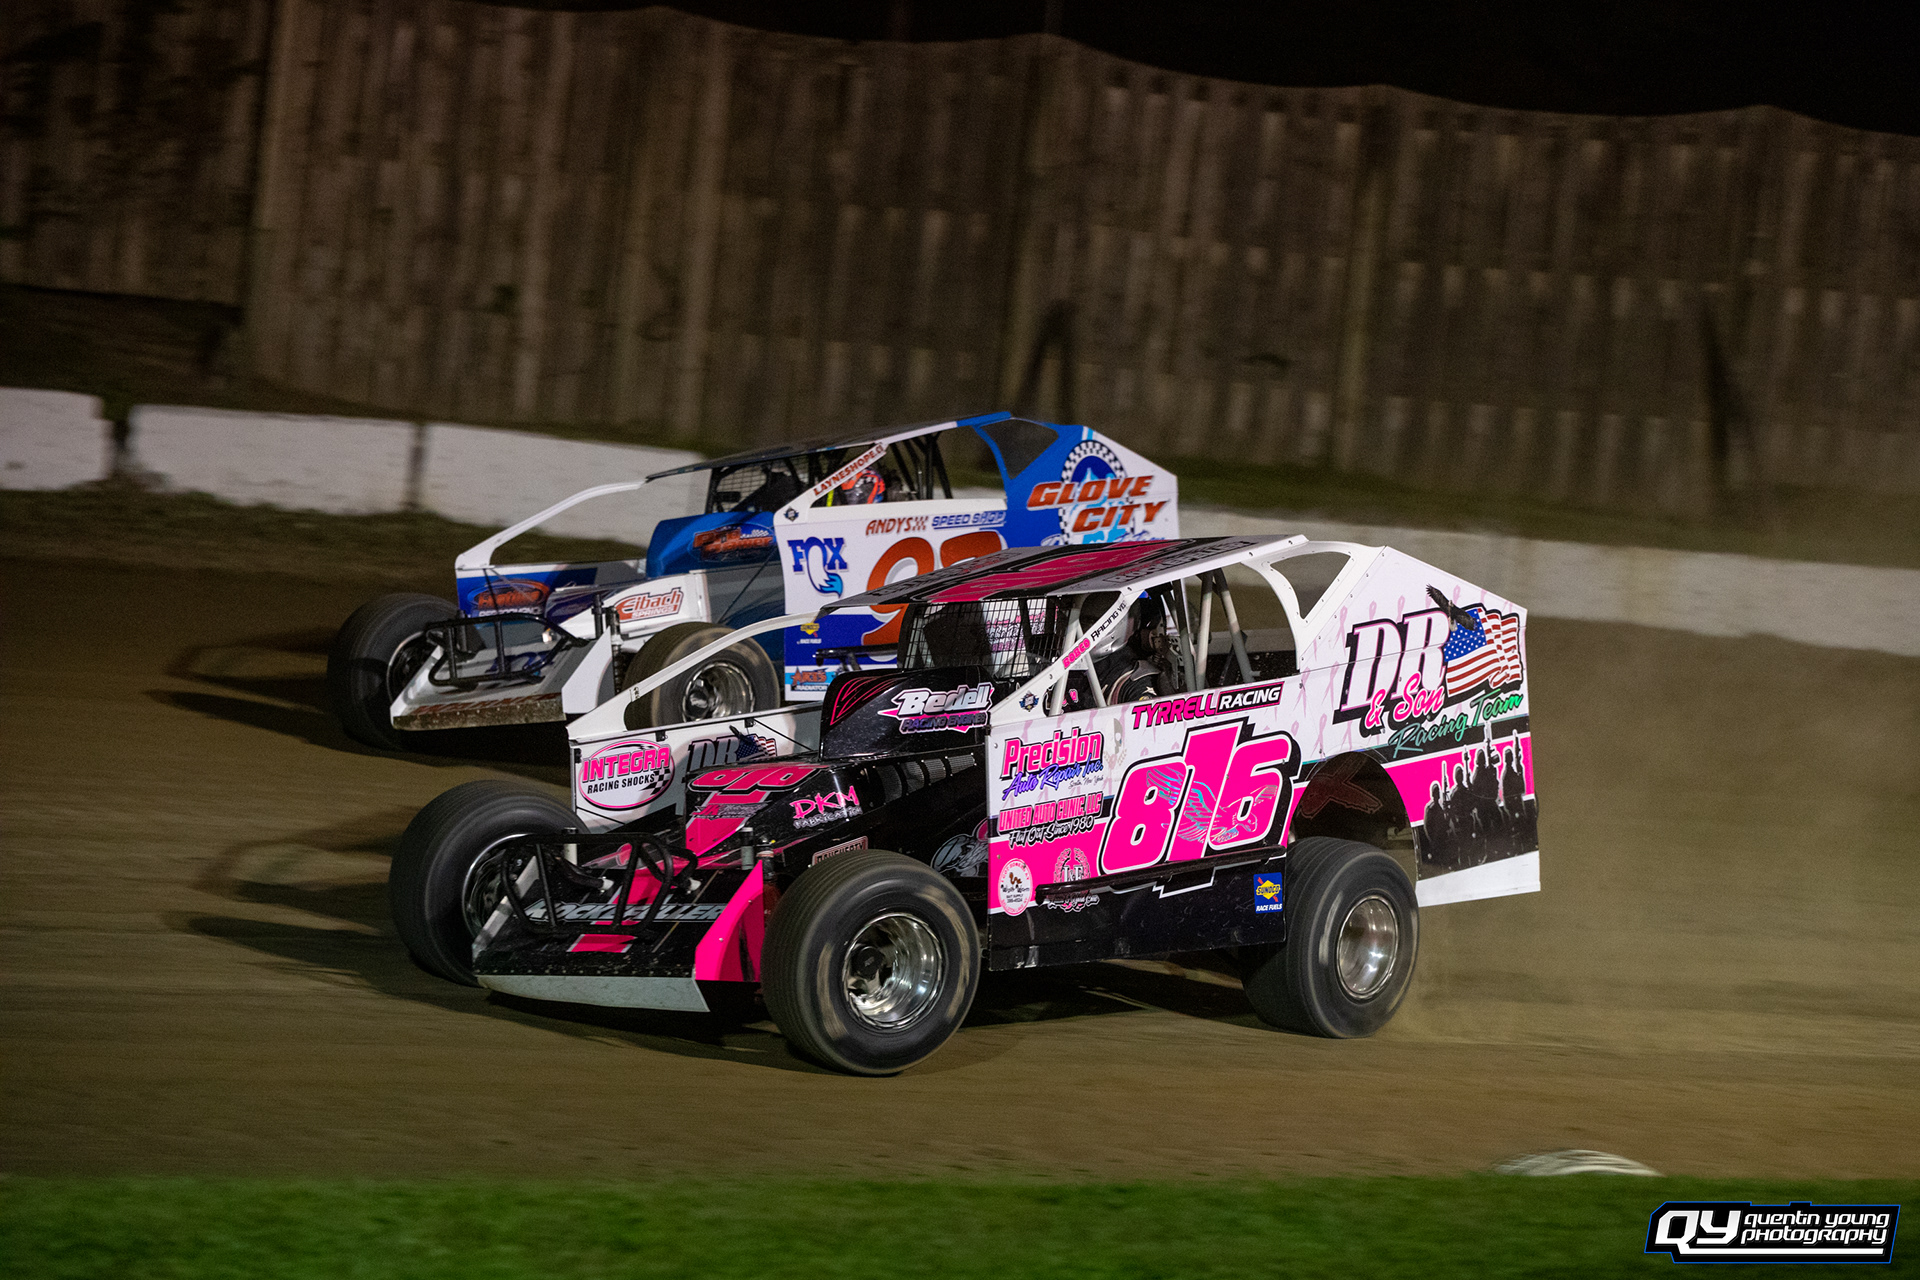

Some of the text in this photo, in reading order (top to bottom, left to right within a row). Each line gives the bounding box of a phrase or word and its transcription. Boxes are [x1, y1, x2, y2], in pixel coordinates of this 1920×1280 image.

[1027, 475, 1154, 508] GLOVE
[932, 514, 971, 527] SPEED
[1072, 500, 1170, 533] CITY
[787, 536, 848, 594] FOX
[615, 590, 681, 619] Eibach
[1335, 608, 1450, 723] DR
[896, 684, 991, 716] Bedell
[1132, 686, 1281, 730] TYRRELL RACING
[1364, 672, 1446, 729] & Son
[901, 712, 987, 732] RACING ENGINES
[1389, 689, 1524, 758] Racing Team
[582, 747, 671, 782] INTEGRA
[1002, 727, 1103, 779] Precision
[587, 773, 655, 794] RACING SHOCKS
[1002, 753, 1103, 800] Auto Repair Inc.
[789, 785, 859, 819] DKM
[998, 805, 1033, 831] UNITED
[1032, 801, 1056, 826] AUTO
[1085, 792, 1103, 815] LLC
[1101, 722, 1293, 874] 816
[1009, 816, 1095, 848] Flat Out Since 1980
